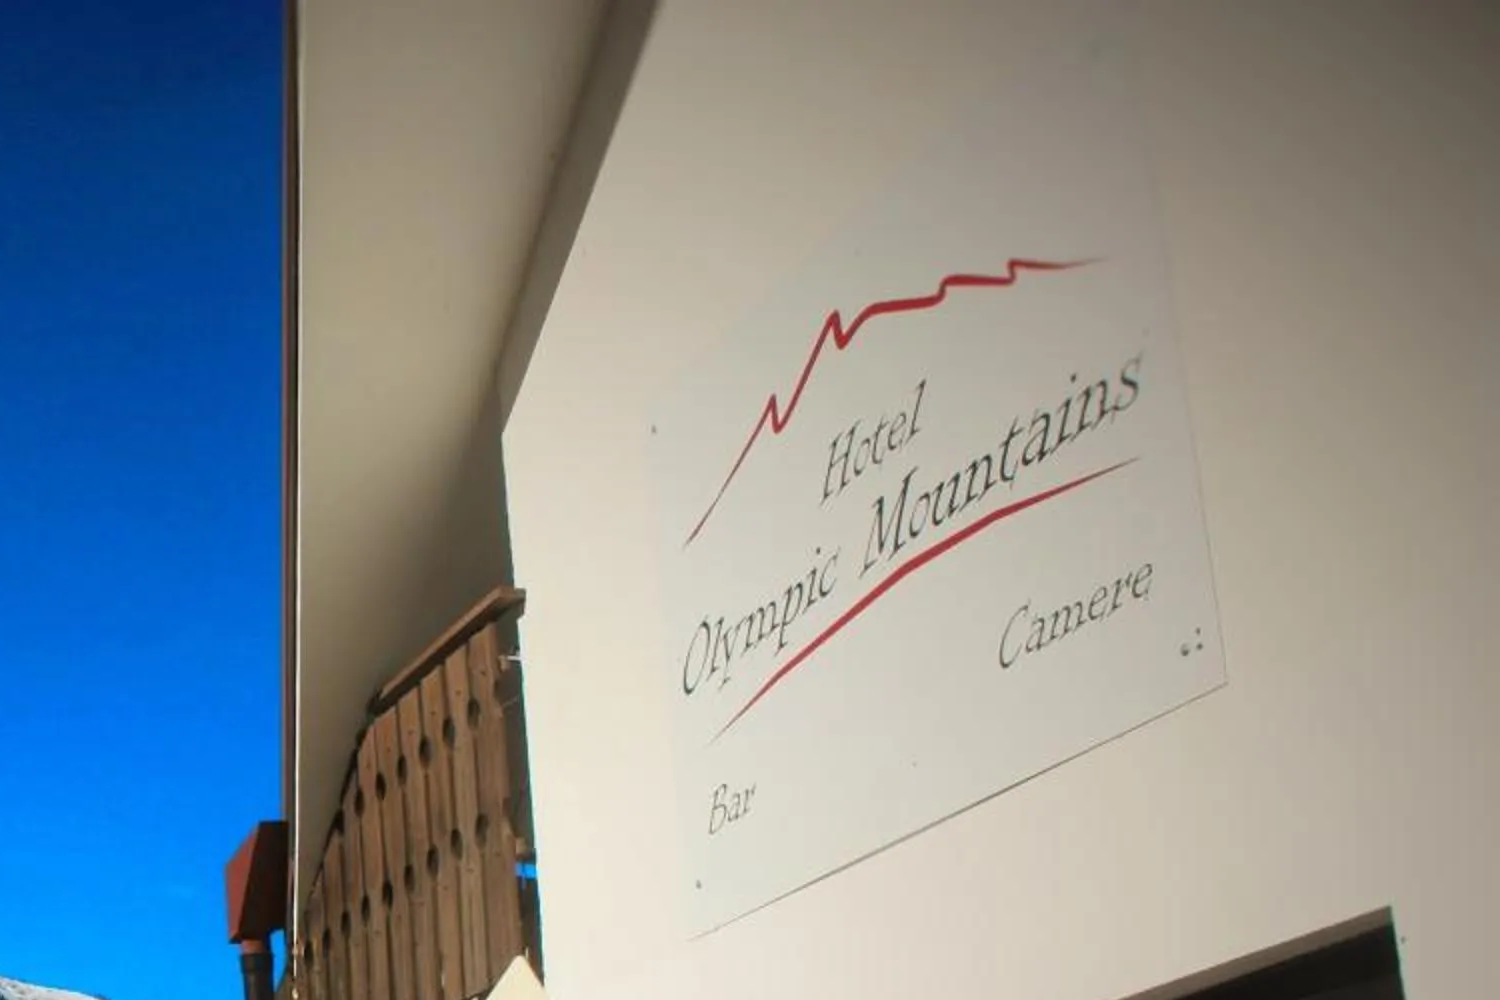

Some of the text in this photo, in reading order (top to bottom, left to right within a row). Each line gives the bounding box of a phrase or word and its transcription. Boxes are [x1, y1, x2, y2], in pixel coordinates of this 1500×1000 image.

[821, 376, 927, 505] Hotel
[682, 352, 1143, 695] Olympic Mountains
[998, 563, 1154, 670] Camere
[708, 782, 757, 836] Bar
